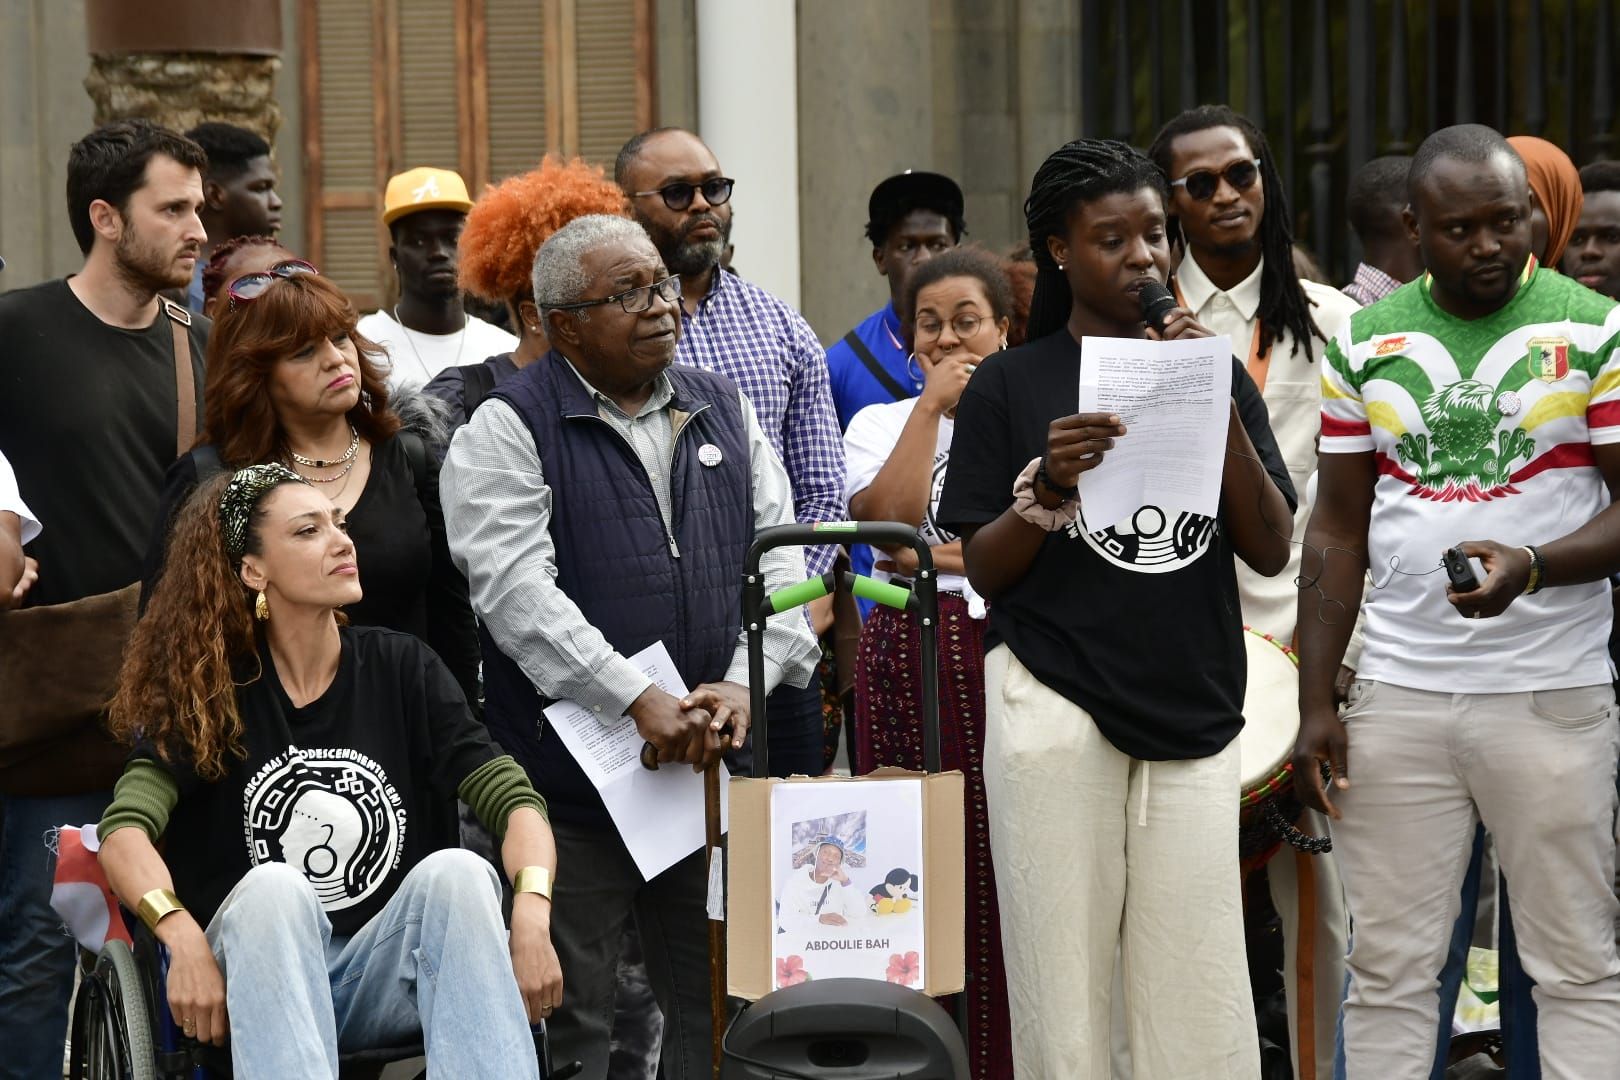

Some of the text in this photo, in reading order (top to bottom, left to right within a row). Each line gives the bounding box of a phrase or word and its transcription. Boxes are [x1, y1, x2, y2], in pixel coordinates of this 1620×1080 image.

[282, 750, 289, 761] Y
[288, 744, 388, 783] AODESCENDIENTES
[392, 808, 407, 870] CANARIAS
[805, 938, 890, 951] ABDOULIE BAH
